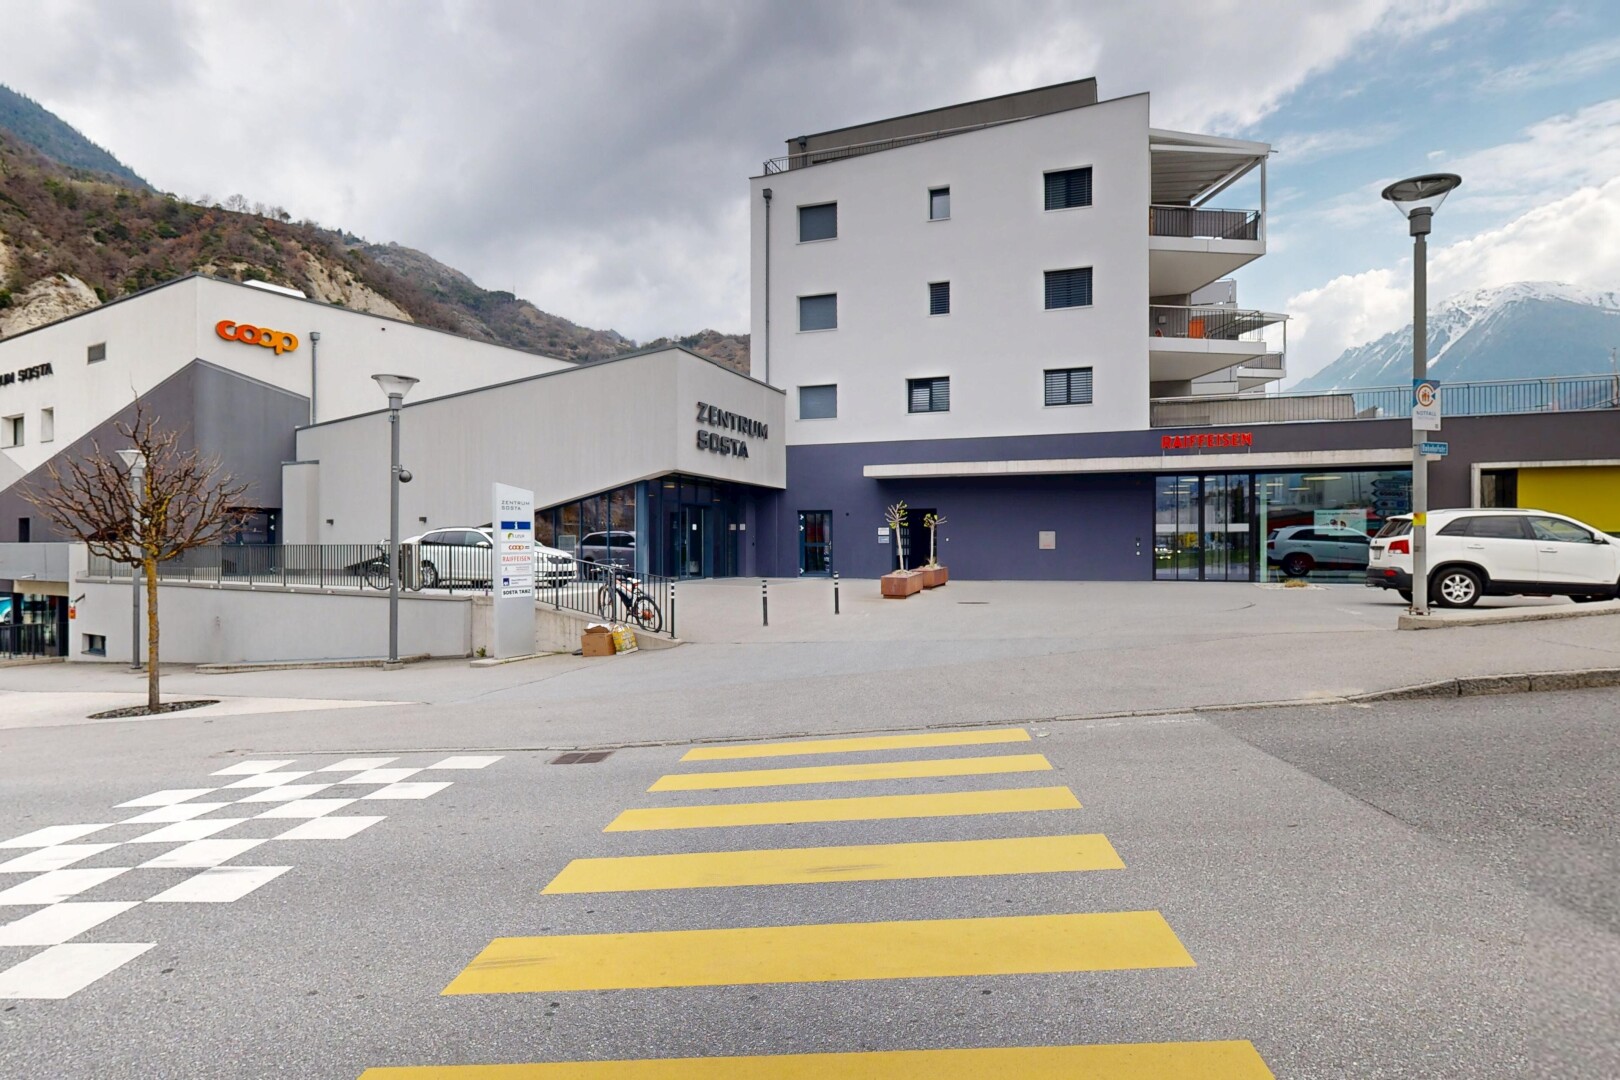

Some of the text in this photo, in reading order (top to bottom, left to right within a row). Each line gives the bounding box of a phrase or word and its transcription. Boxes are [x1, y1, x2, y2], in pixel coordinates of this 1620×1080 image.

[215, 320, 299, 355] coop
[18, 362, 53, 382] SOSTA
[696, 401, 768, 440] ZENTRUM
[697, 429, 749, 459] SOSTA
[1161, 432, 1252, 449] RAIFFEISEN
[502, 555, 531, 563] RAIFFEISEN
